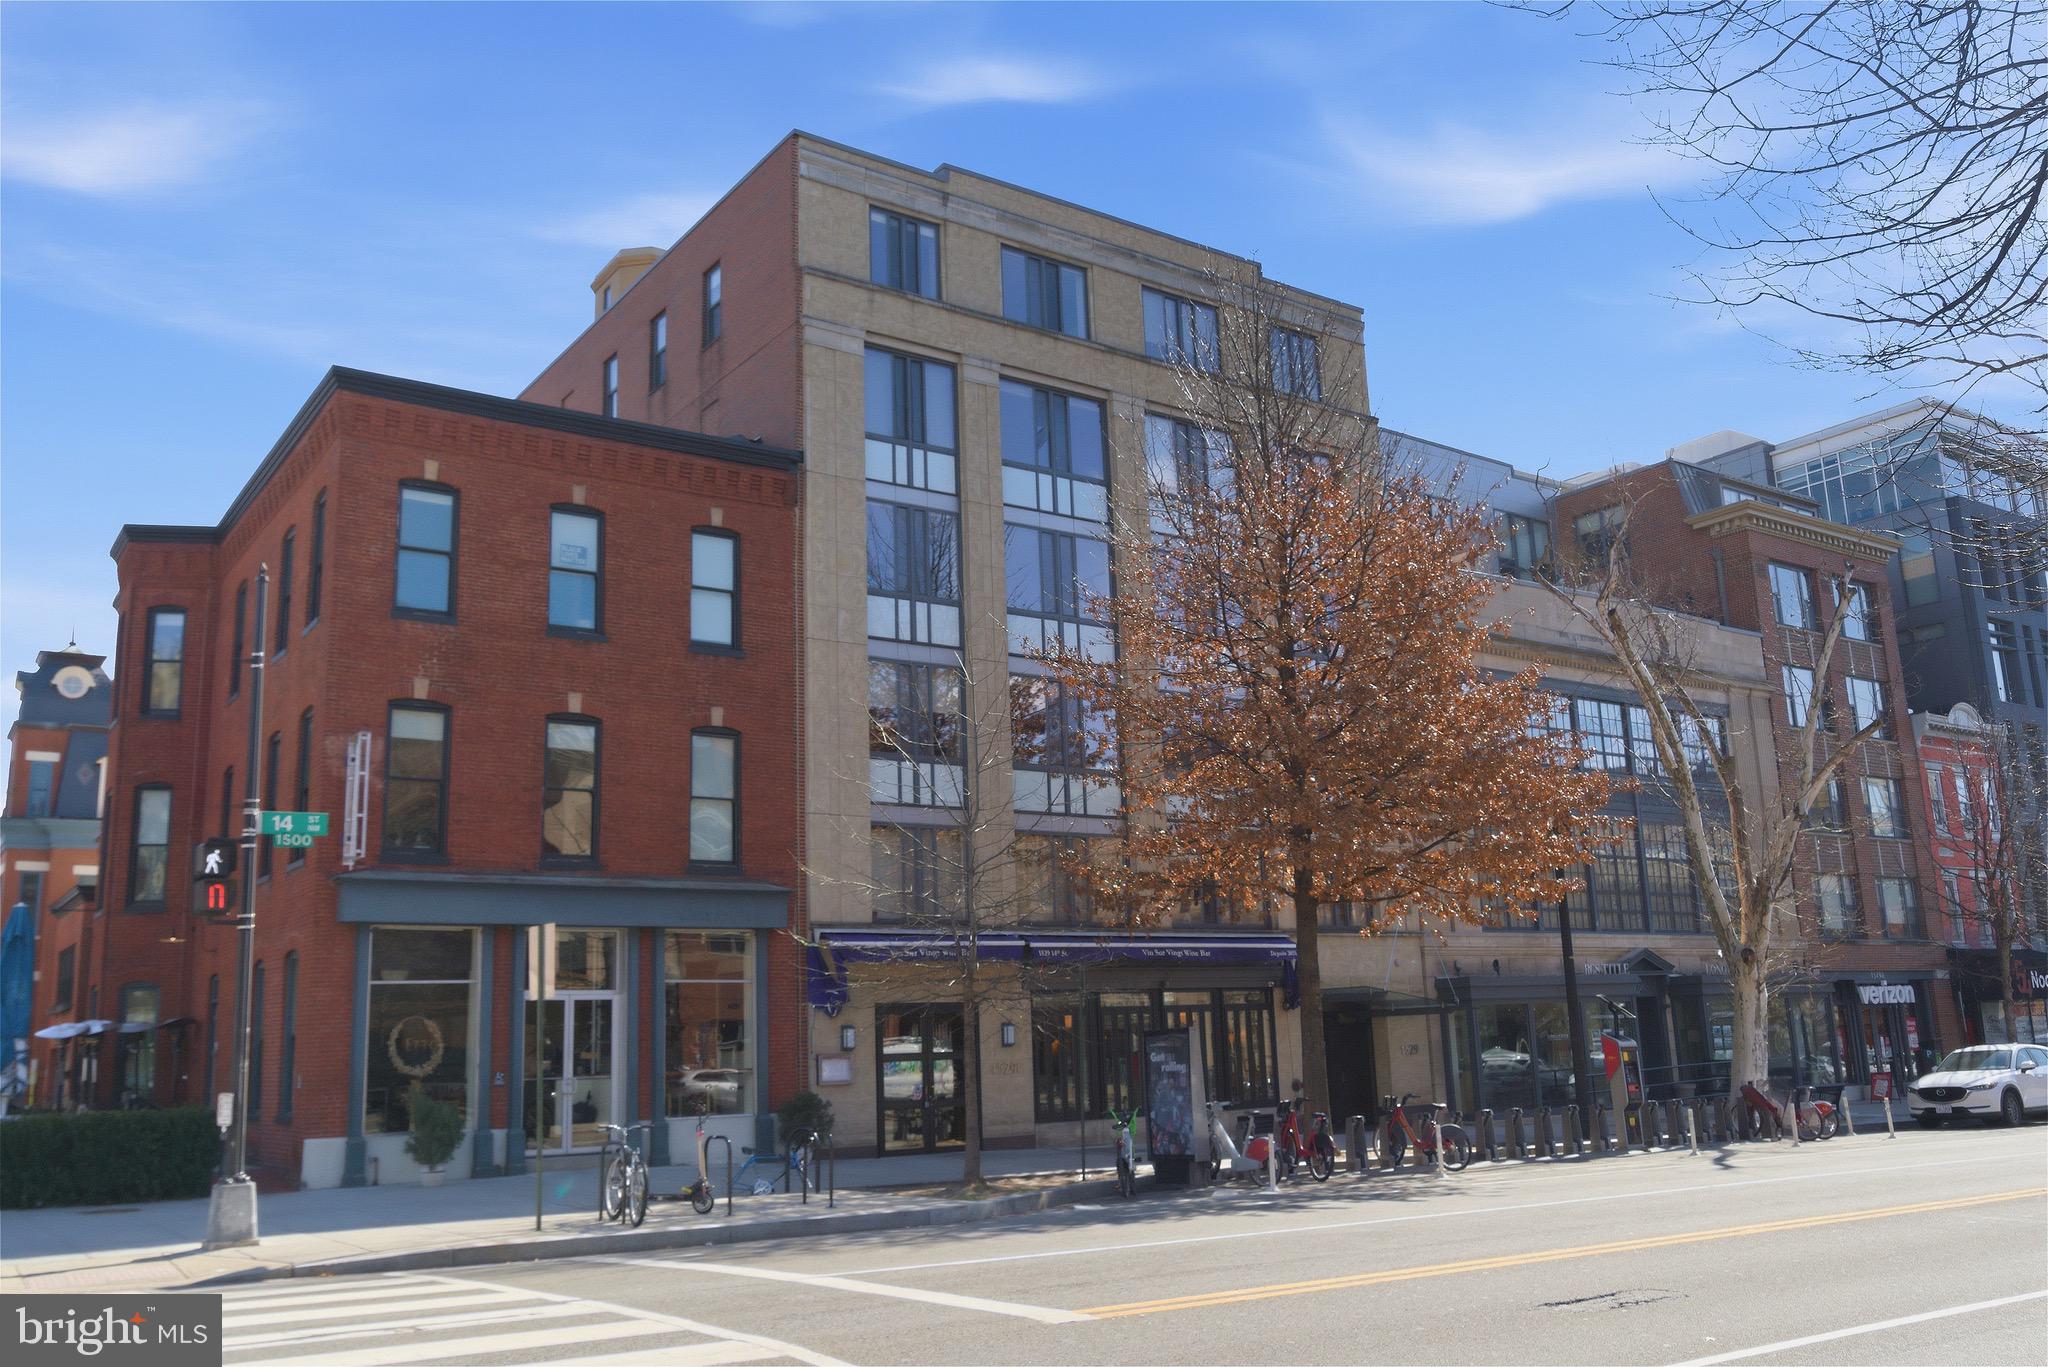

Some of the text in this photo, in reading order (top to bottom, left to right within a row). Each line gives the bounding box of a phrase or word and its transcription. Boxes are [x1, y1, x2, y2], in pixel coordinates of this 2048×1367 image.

[272, 815, 293, 832] 14
[276, 834, 312, 846] 1500
[1859, 980, 1916, 1004] verizon
[1161, 1061, 1187, 1073] rolling
